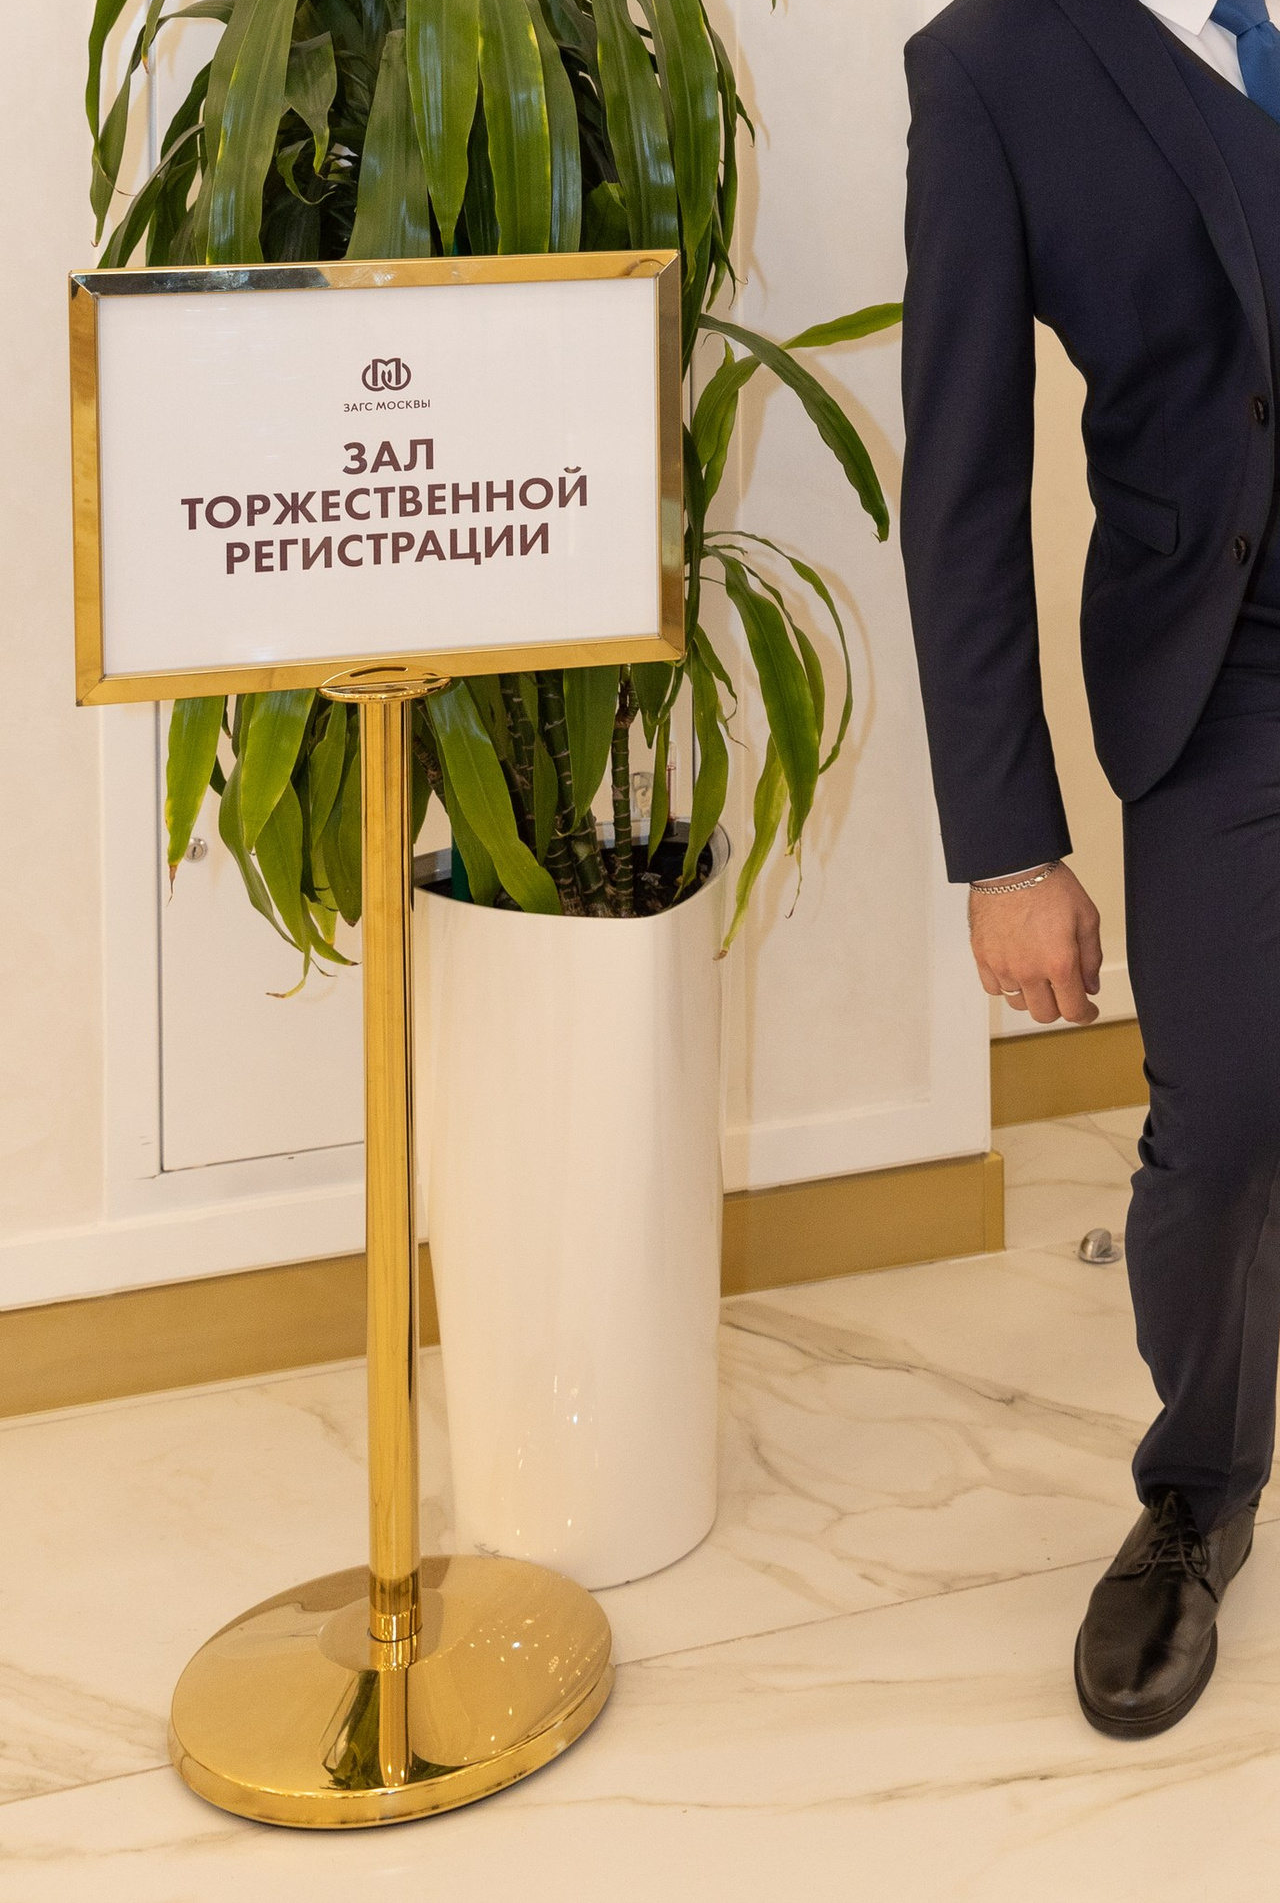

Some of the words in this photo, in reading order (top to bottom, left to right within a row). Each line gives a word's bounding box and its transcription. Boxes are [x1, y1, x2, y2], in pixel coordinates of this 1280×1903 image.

[343, 402, 373, 413] ЗАГС
[375, 399, 431, 411] МОСКВЫ
[342, 438, 434, 475] ЗАЛ
[180, 465, 588, 531] ТОРЖЕСТВЕННОЙ
[225, 522, 549, 575] РЕГИСТРАЦИИ
